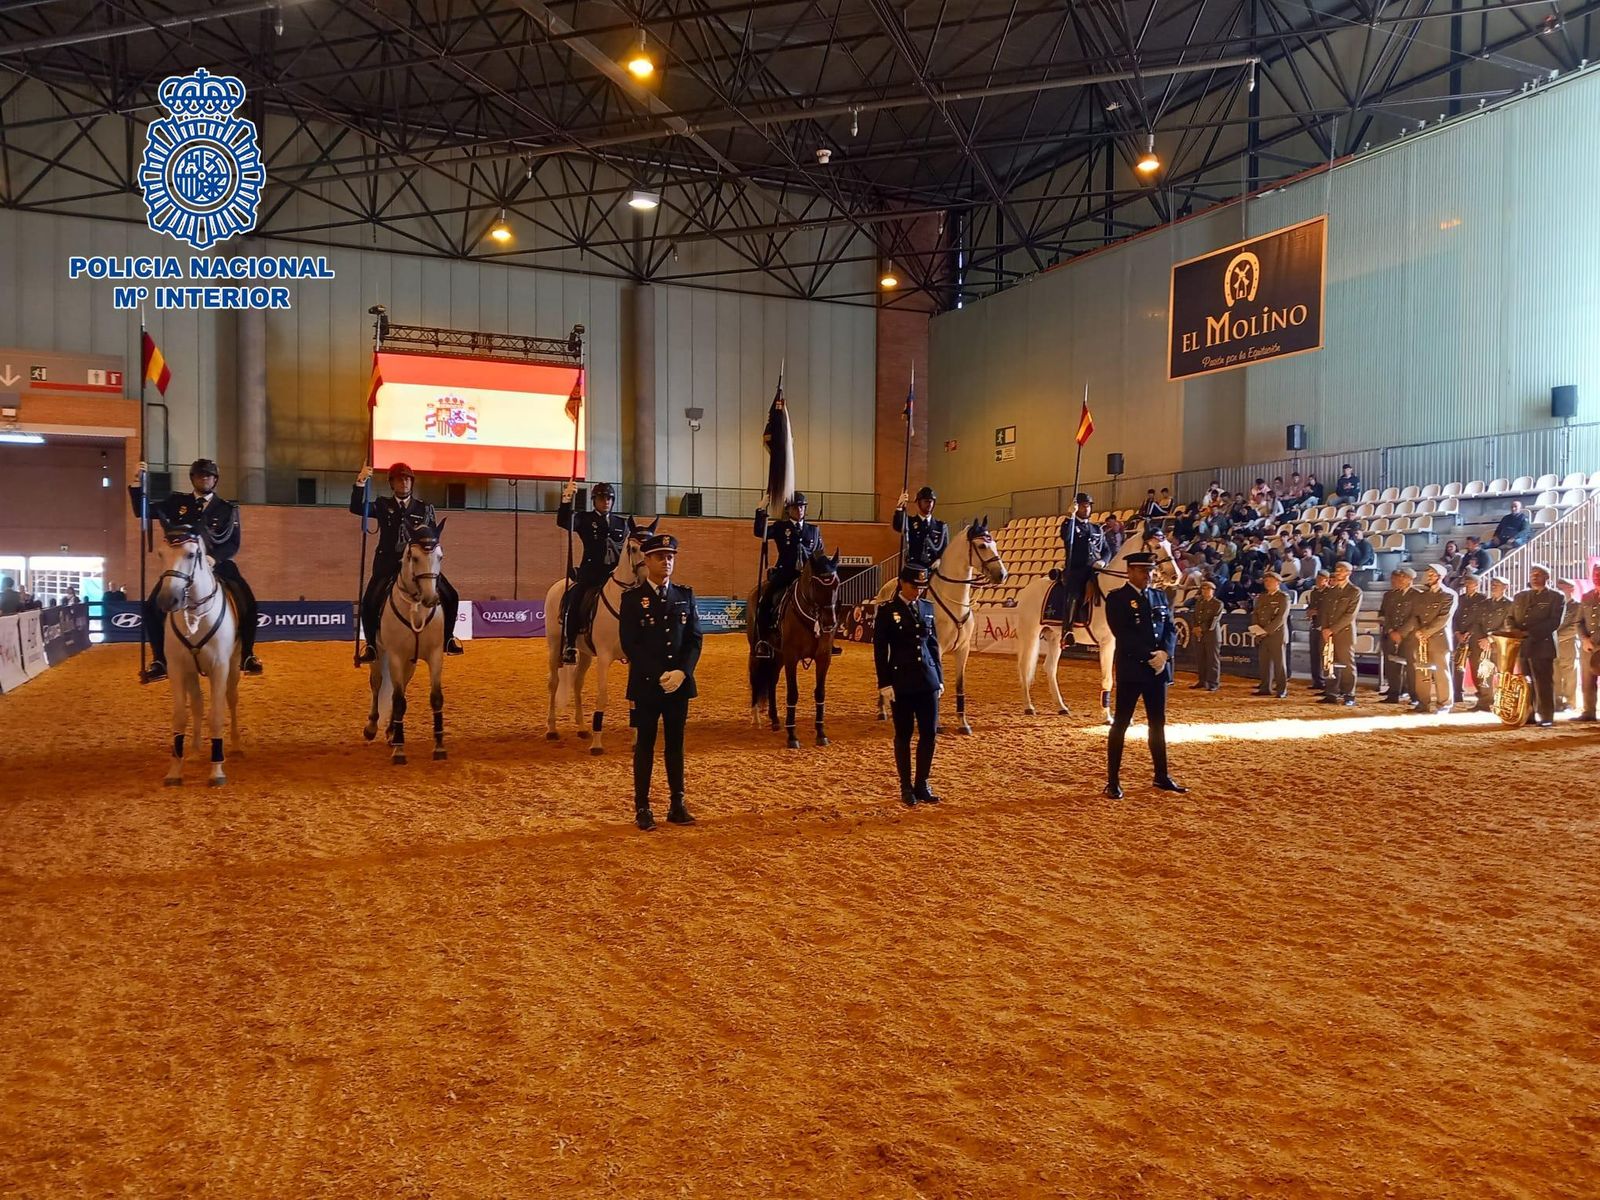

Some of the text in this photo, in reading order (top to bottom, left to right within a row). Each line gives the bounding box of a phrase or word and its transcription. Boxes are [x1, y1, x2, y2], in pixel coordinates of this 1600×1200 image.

[1182, 331, 1200, 353] EL
[275, 614, 346, 625] HYUNDAI
[482, 611, 515, 621] QATAR
